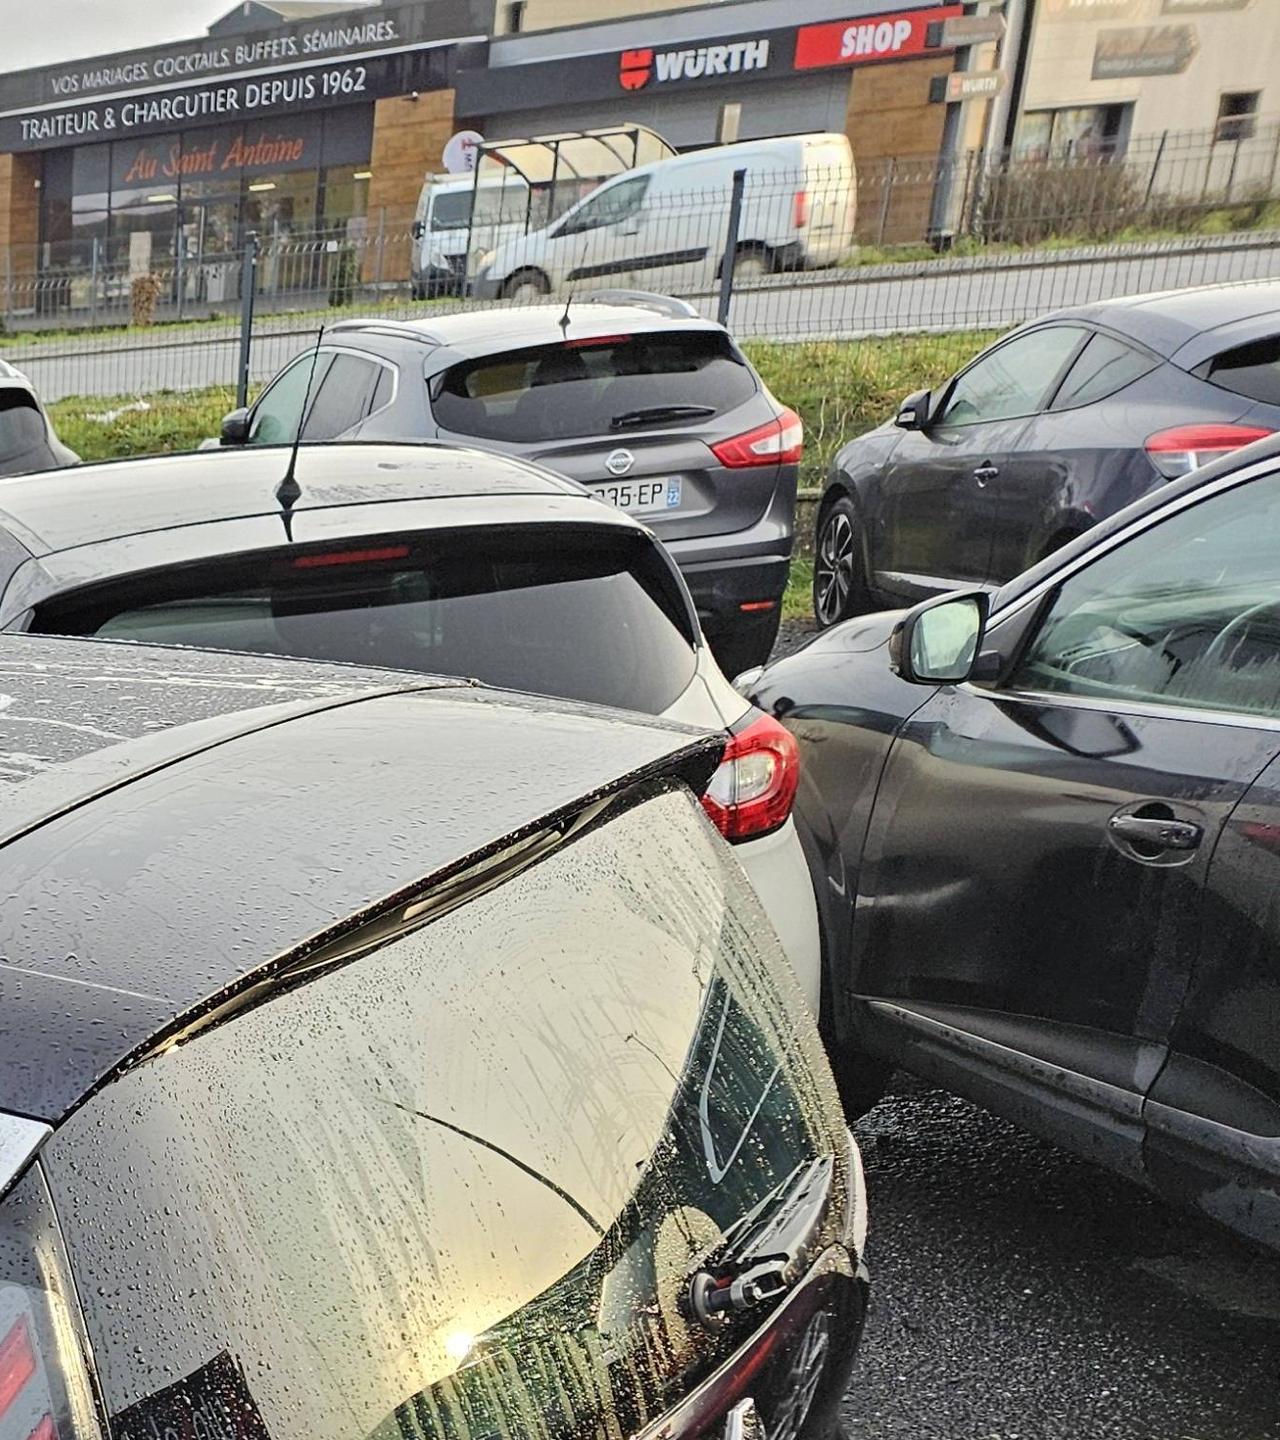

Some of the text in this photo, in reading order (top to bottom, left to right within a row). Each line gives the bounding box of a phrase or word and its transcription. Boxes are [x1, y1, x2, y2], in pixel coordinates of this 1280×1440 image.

[840, 20, 912, 57] SHOP
[20, 66, 367, 141] TRAITEUR & CHARCUTIER DEPUIS 1962
[51, 75, 79, 94] VOS
[124, 133, 305, 183] Au Saint Antoine
